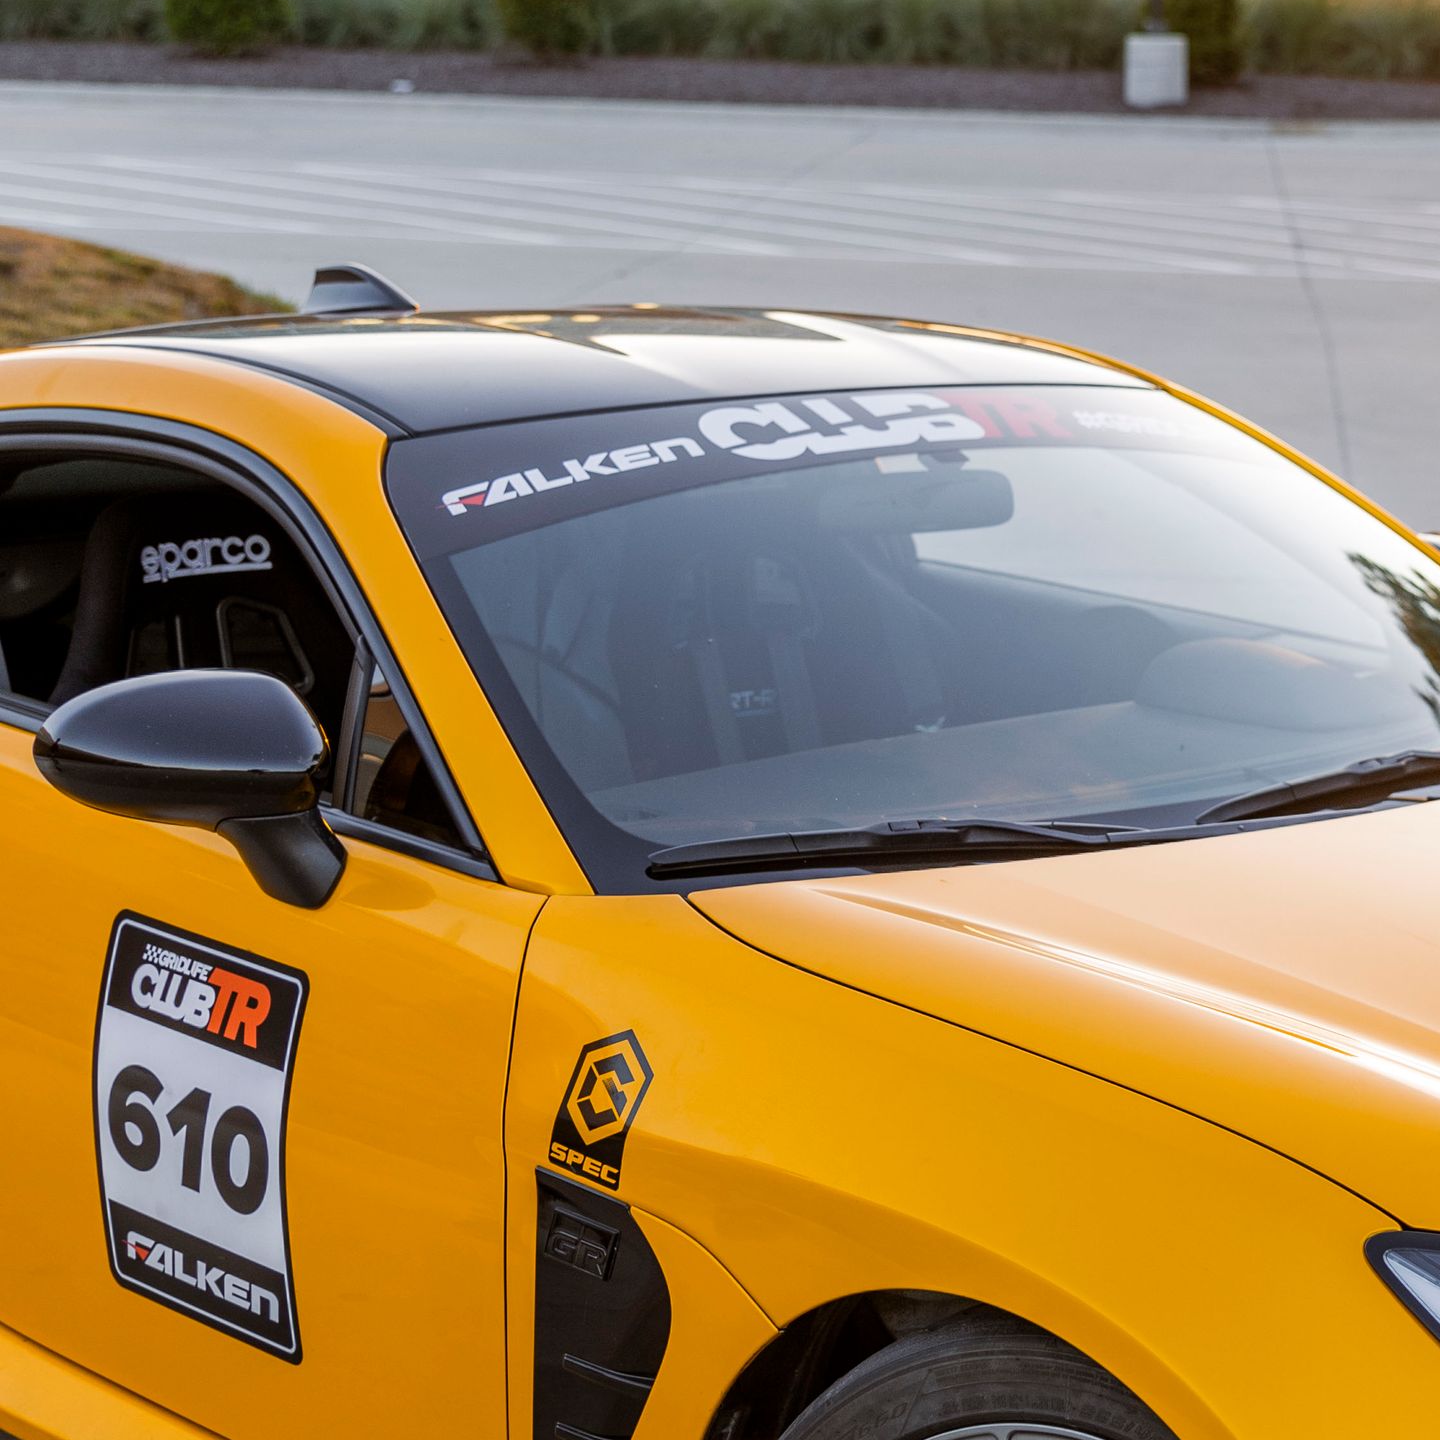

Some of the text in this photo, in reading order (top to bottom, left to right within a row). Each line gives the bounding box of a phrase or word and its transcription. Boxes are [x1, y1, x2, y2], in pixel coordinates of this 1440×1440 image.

[438, 436, 706, 516] FALKEN
[158, 948, 214, 982] GRIDLIFE
[108, 1064, 269, 1215] 610
[550, 1141, 620, 1185] SPEC
[125, 1230, 280, 1324] FALKEN
